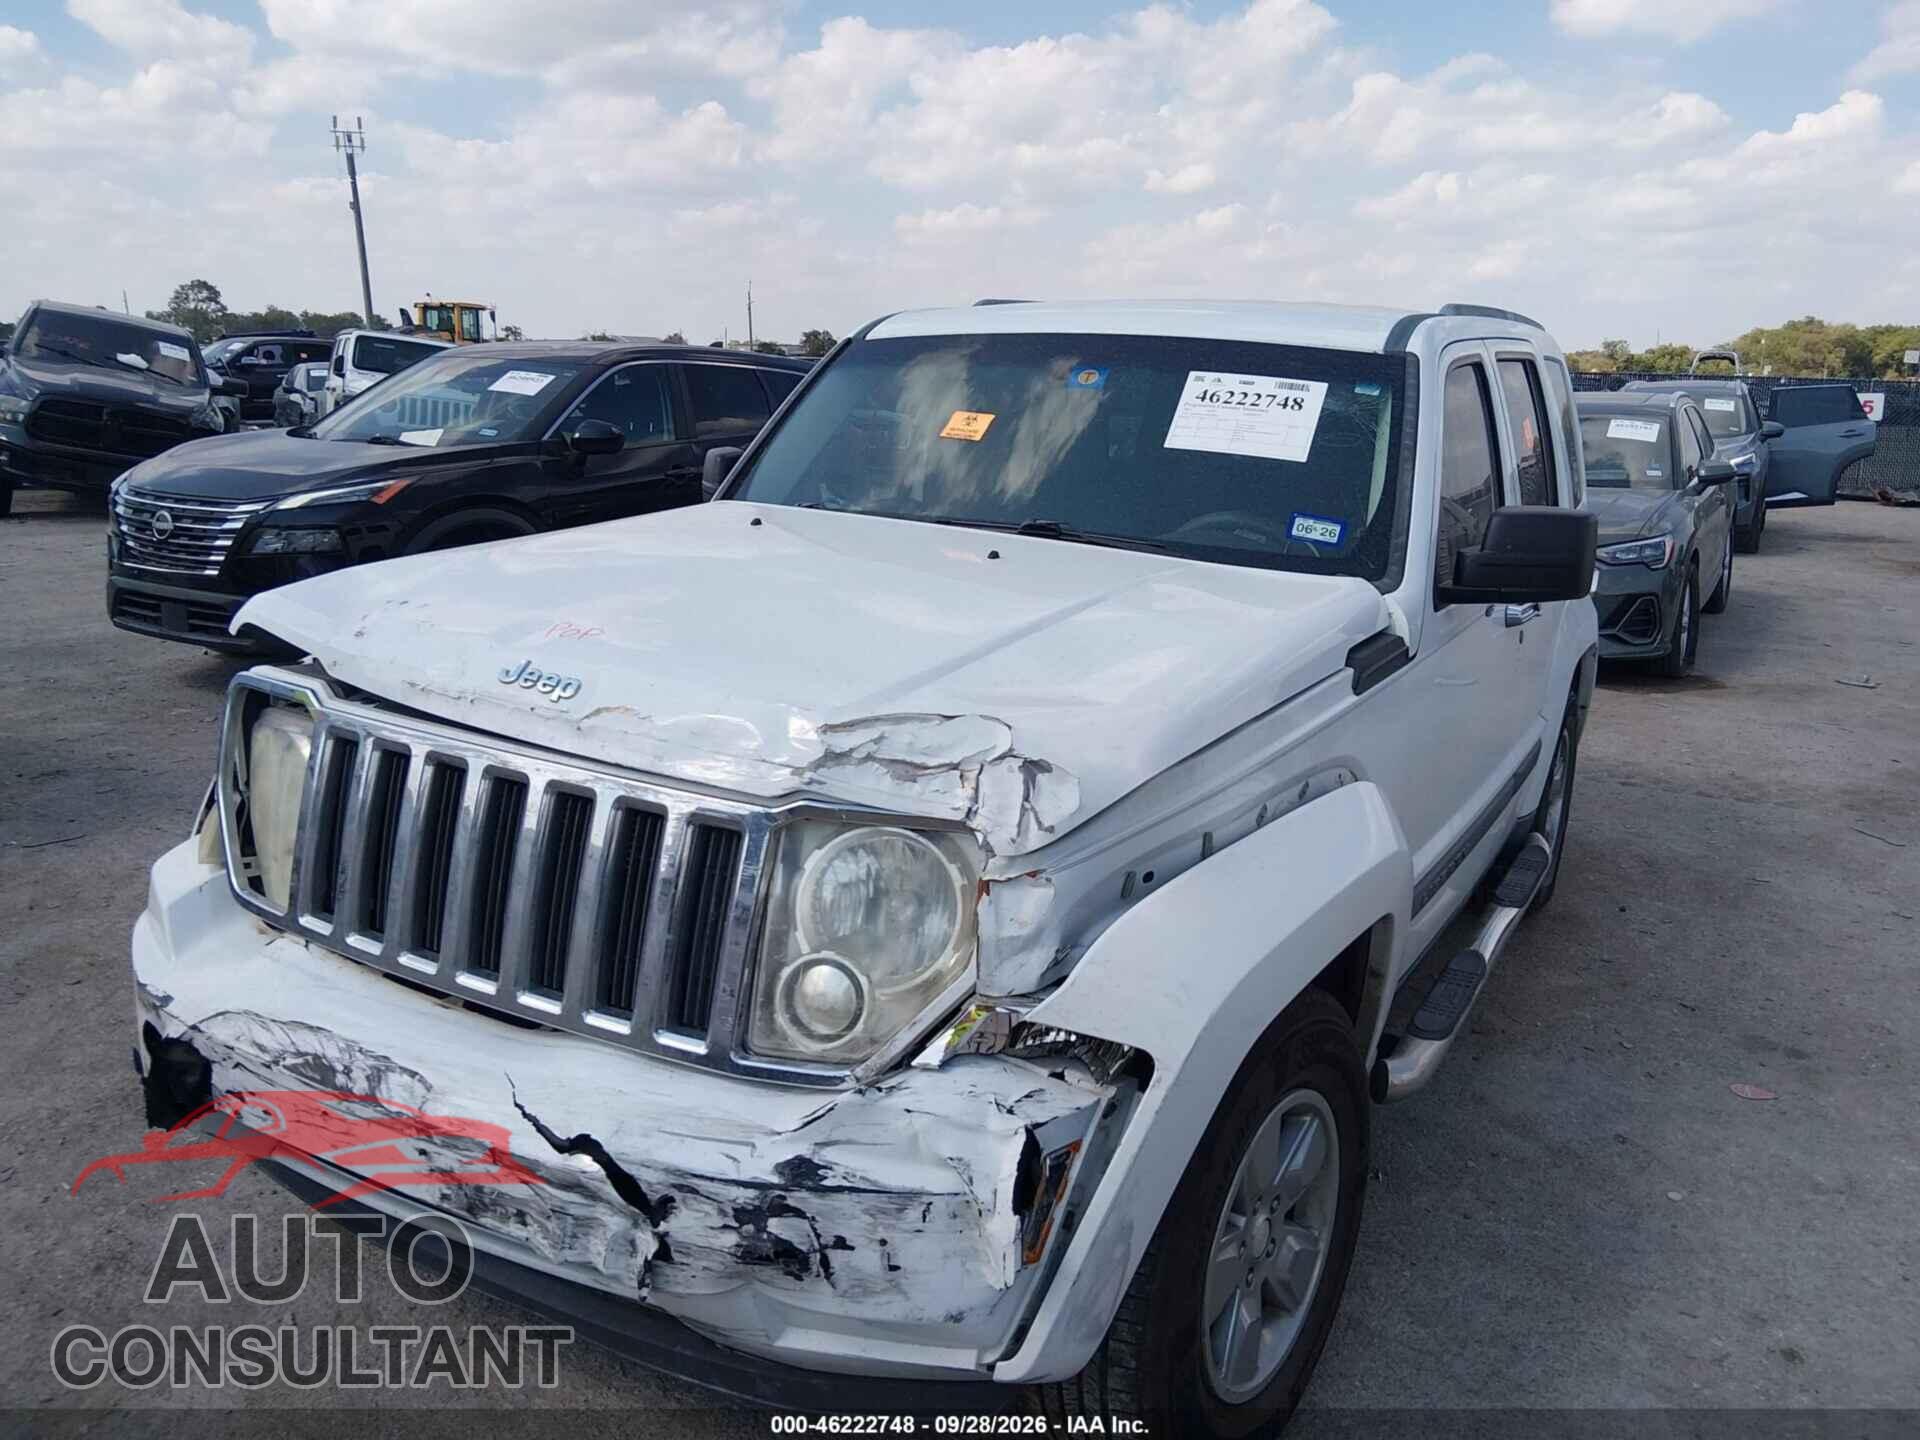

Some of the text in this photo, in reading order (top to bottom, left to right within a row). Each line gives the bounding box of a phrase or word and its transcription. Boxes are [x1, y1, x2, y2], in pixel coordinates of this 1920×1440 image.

[1195, 388, 1305, 412] 46222748
[1863, 400, 1875, 415] 5
[1296, 522, 1337, 539] 06 26
[497, 659, 582, 703] Jeep
